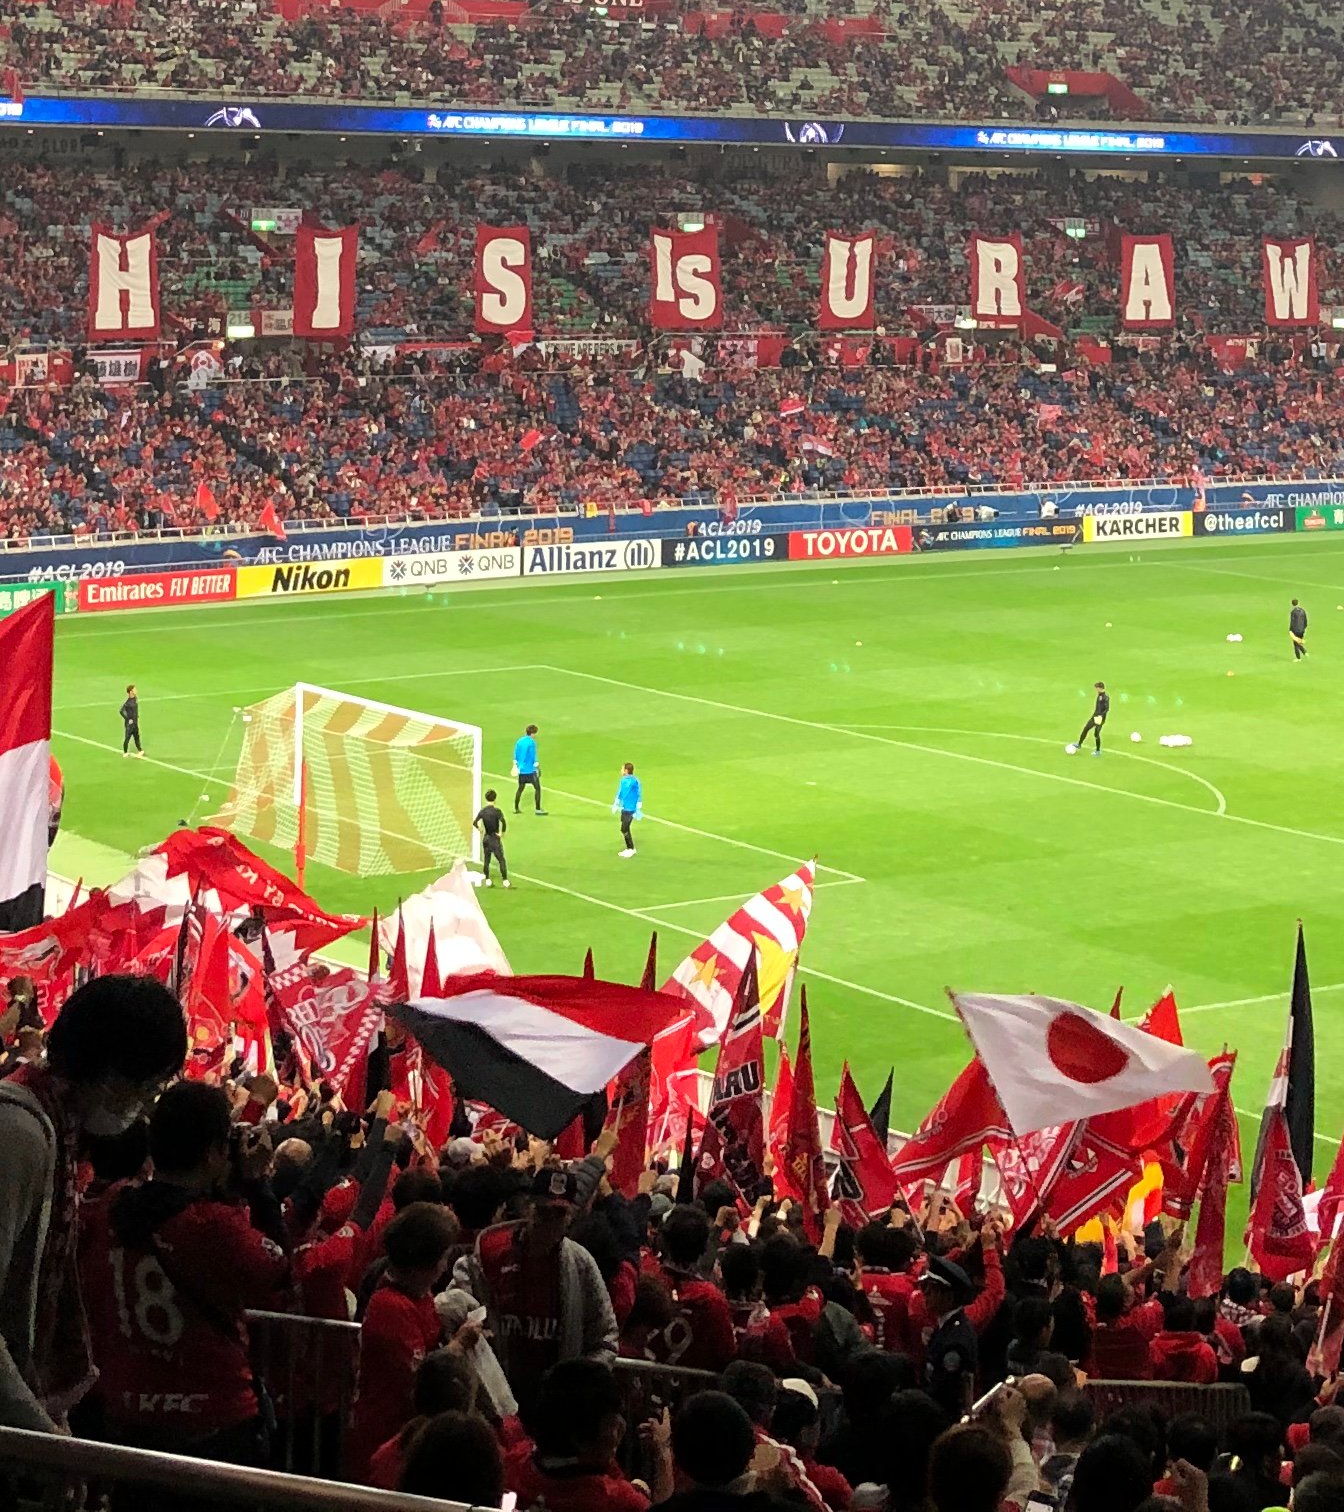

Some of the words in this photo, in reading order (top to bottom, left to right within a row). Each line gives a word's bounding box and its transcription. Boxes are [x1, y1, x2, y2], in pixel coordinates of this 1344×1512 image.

[1263, 494, 1285, 509] AFC
[697, 518, 762, 536] ACL2019
[1096, 517, 1180, 537] KÄRCHER
[1204, 510, 1284, 531] @theafccl
[803, 529, 899, 555] TOYOTA
[950, 529, 993, 541] CHAMPIONS
[994, 527, 1022, 539] LEAGUE
[255, 546, 283, 566] AFC
[288, 540, 385, 562] CHAMPIONS
[391, 535, 452, 556] LEAGUE
[524, 527, 574, 547] 2019
[674, 539, 775, 562] #ACL2019
[411, 558, 448, 577] QNB
[478, 553, 515, 571] QNB
[529, 546, 617, 573] Allianz
[28, 560, 125, 583] #ACL2019
[271, 566, 351, 593] Nikon
[87, 580, 164, 604] Emirates
[169, 576, 189, 598] FLY
[192, 573, 231, 596] BETTER
[108, 1246, 185, 1347] 18
